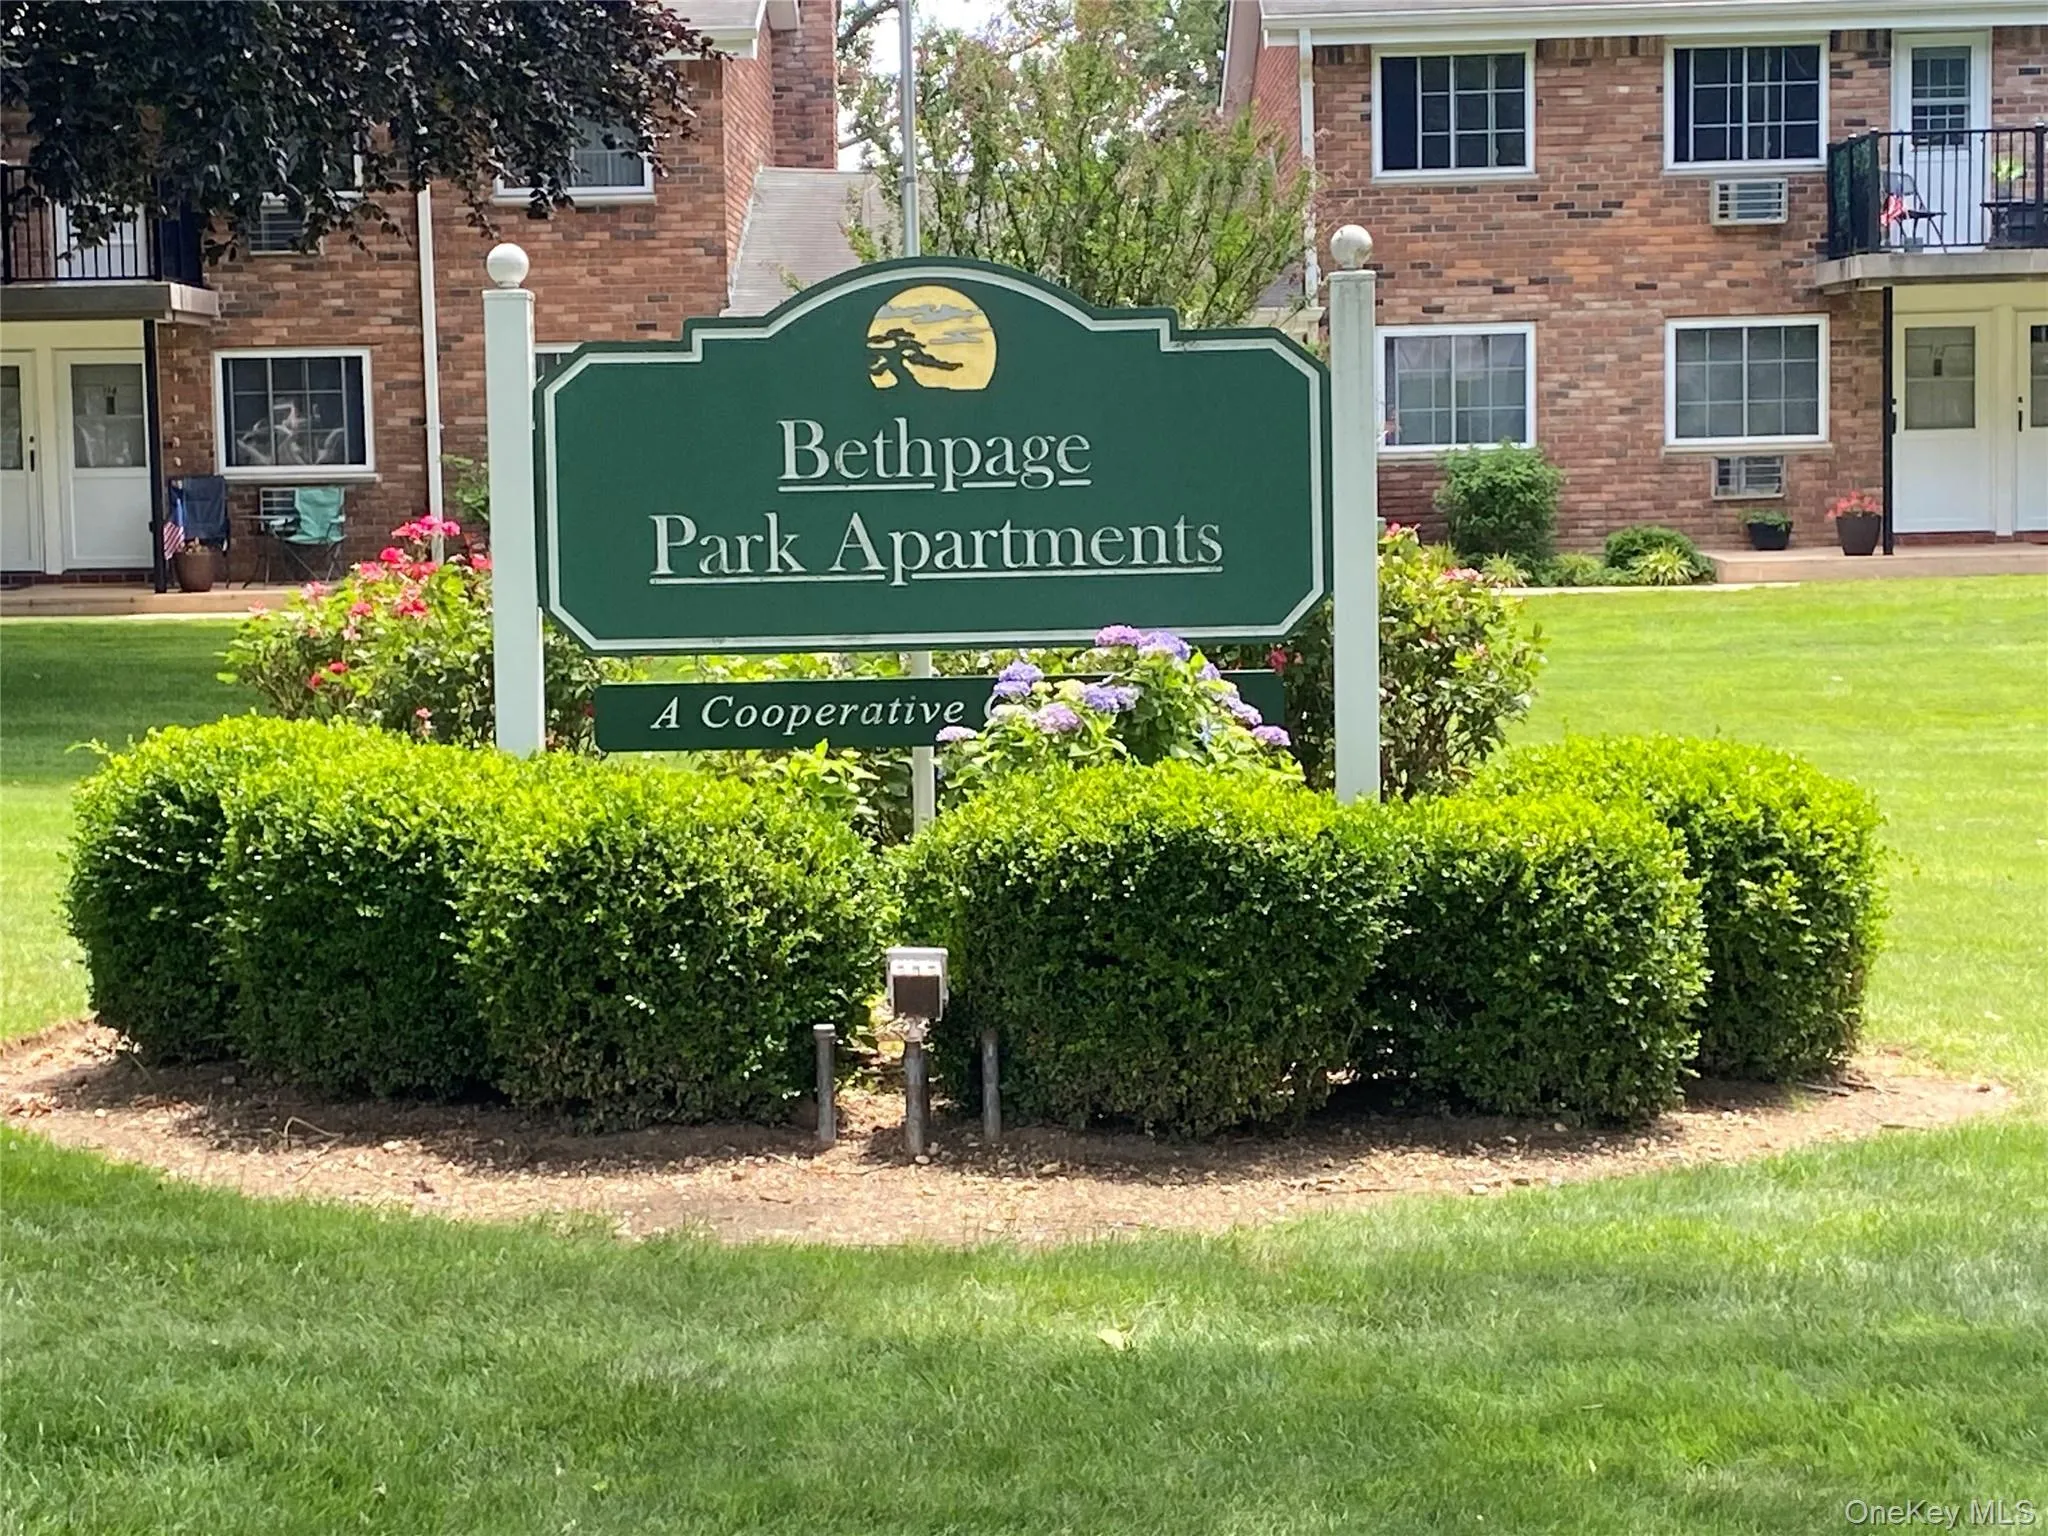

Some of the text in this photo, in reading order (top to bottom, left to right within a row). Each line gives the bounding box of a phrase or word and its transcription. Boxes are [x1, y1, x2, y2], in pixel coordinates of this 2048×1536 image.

[776, 417, 1092, 492] Bethpage
[648, 511, 1223, 586] Park Apartments
[650, 696, 680, 729] A
[701, 695, 965, 736] Cooperative
